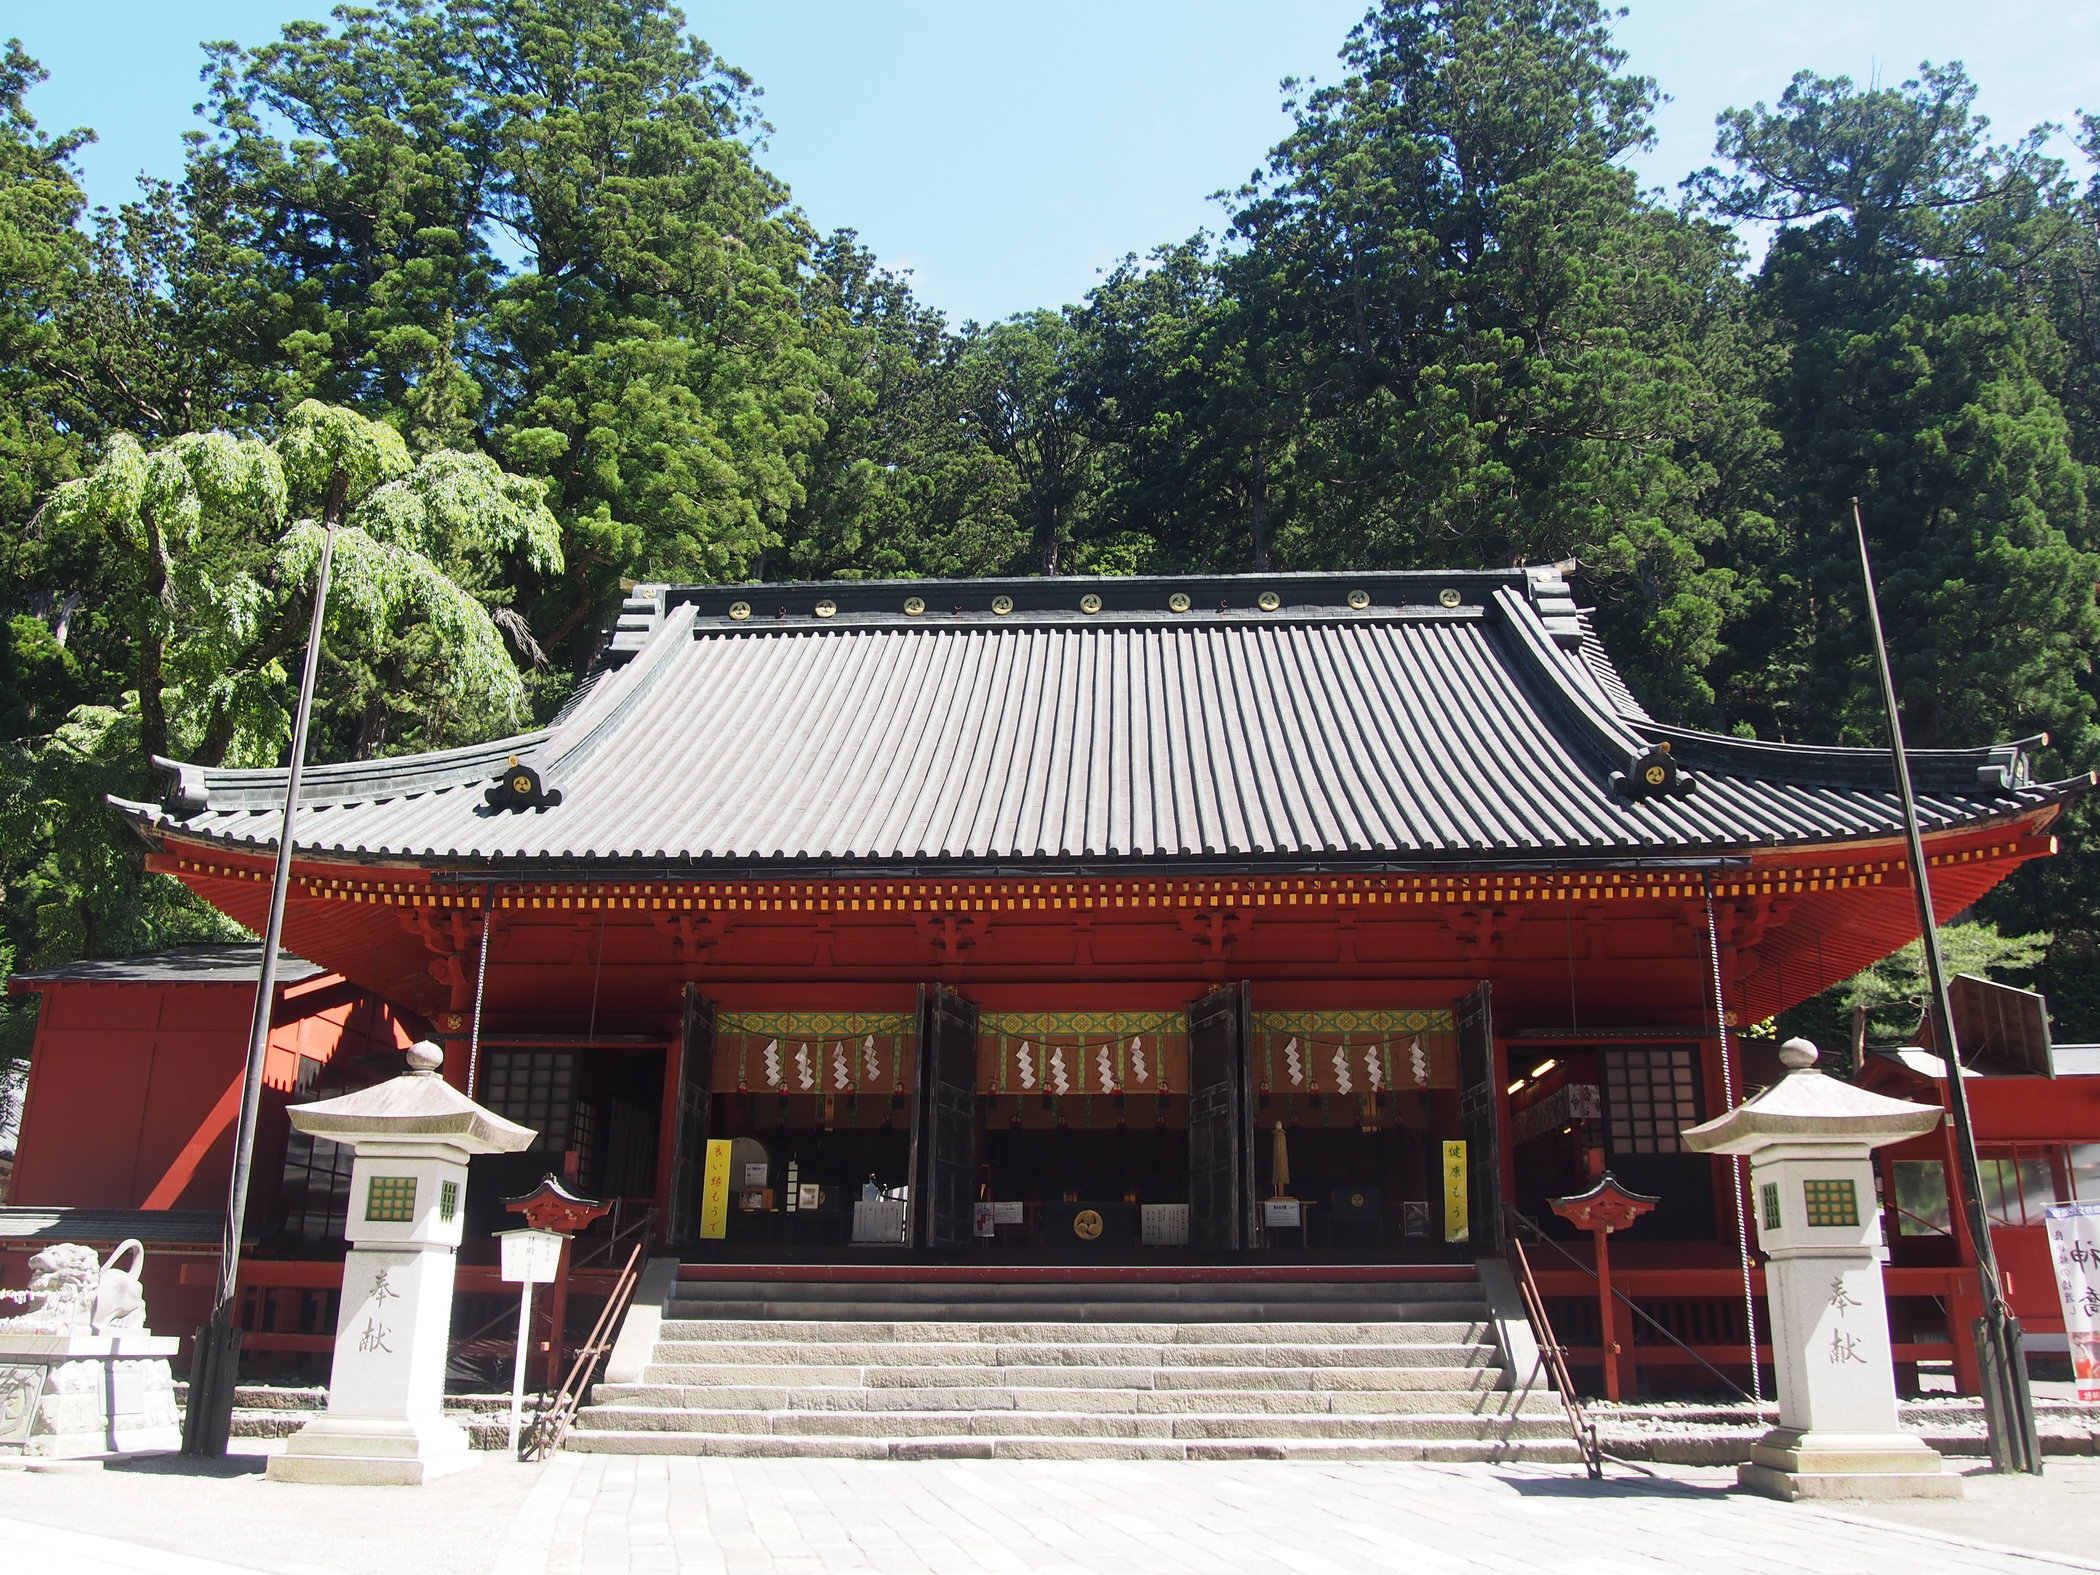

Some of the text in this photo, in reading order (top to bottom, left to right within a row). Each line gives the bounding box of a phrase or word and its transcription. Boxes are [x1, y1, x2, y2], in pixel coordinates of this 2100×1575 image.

[709, 1145, 723, 1232] 良い縁もうで
[358, 1269, 400, 1353] 奉献
[1828, 1276, 1868, 1364] 奉献
